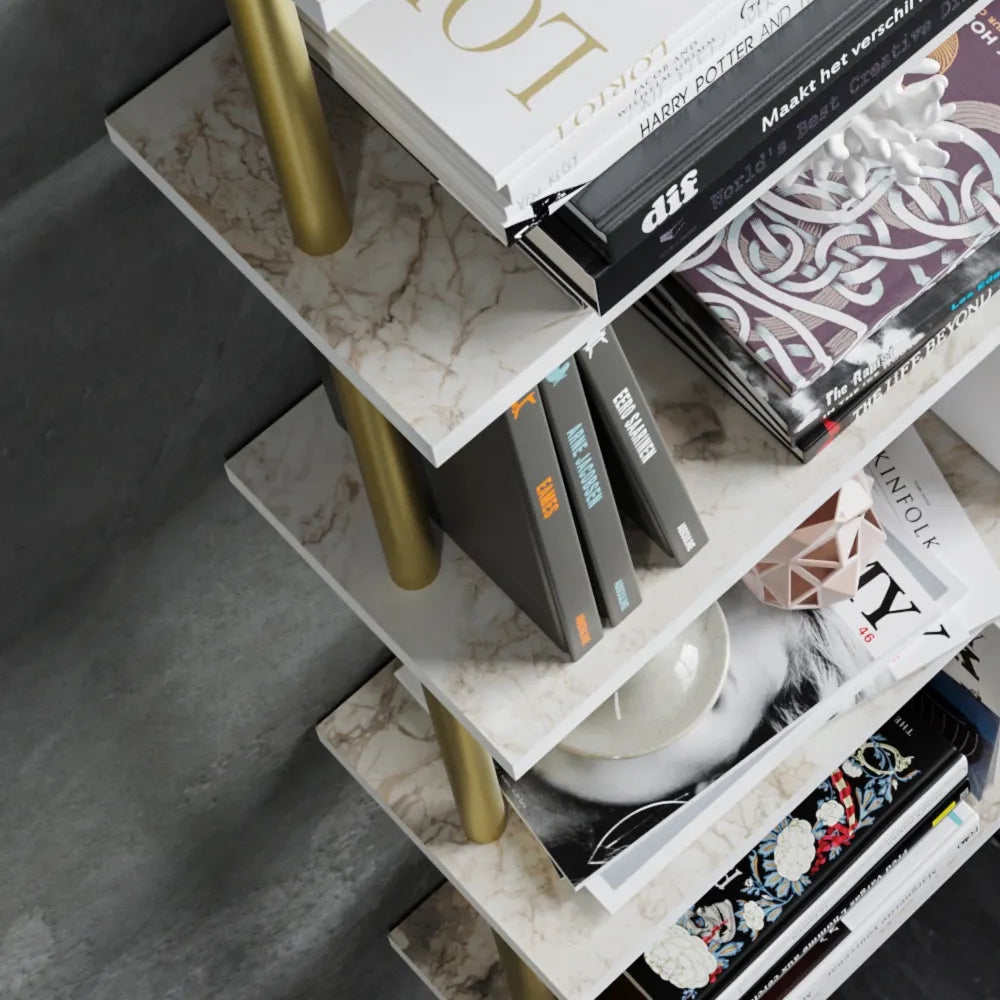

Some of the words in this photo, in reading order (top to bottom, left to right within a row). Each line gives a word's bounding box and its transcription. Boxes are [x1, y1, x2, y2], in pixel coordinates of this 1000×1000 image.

[966, 17, 999, 47] HO
[639, 86, 689, 139] HARRY
[694, 34, 755, 93] POTTER
[760, 4, 792, 41] AND
[641, 168, 699, 233] dif
[760, 77, 817, 133] Maakt
[819, 51, 849, 85] het
[709, 139, 788, 211] World's
[796, 96, 841, 140] Best
[850, 19, 933, 95] Creative
[825, 383, 848, 407] The
[852, 387, 883, 422] THE
[883, 352, 925, 392] LIFE
[565, 421, 589, 459] ARNE
[611, 386, 635, 421] EERO
[623, 410, 659, 466] SAARINEN
[534, 475, 561, 521] EAMES
[575, 451, 604, 511] JACOBSEN
[872, 449, 941, 550] KINFOLK
[857, 625, 877, 645] 46
